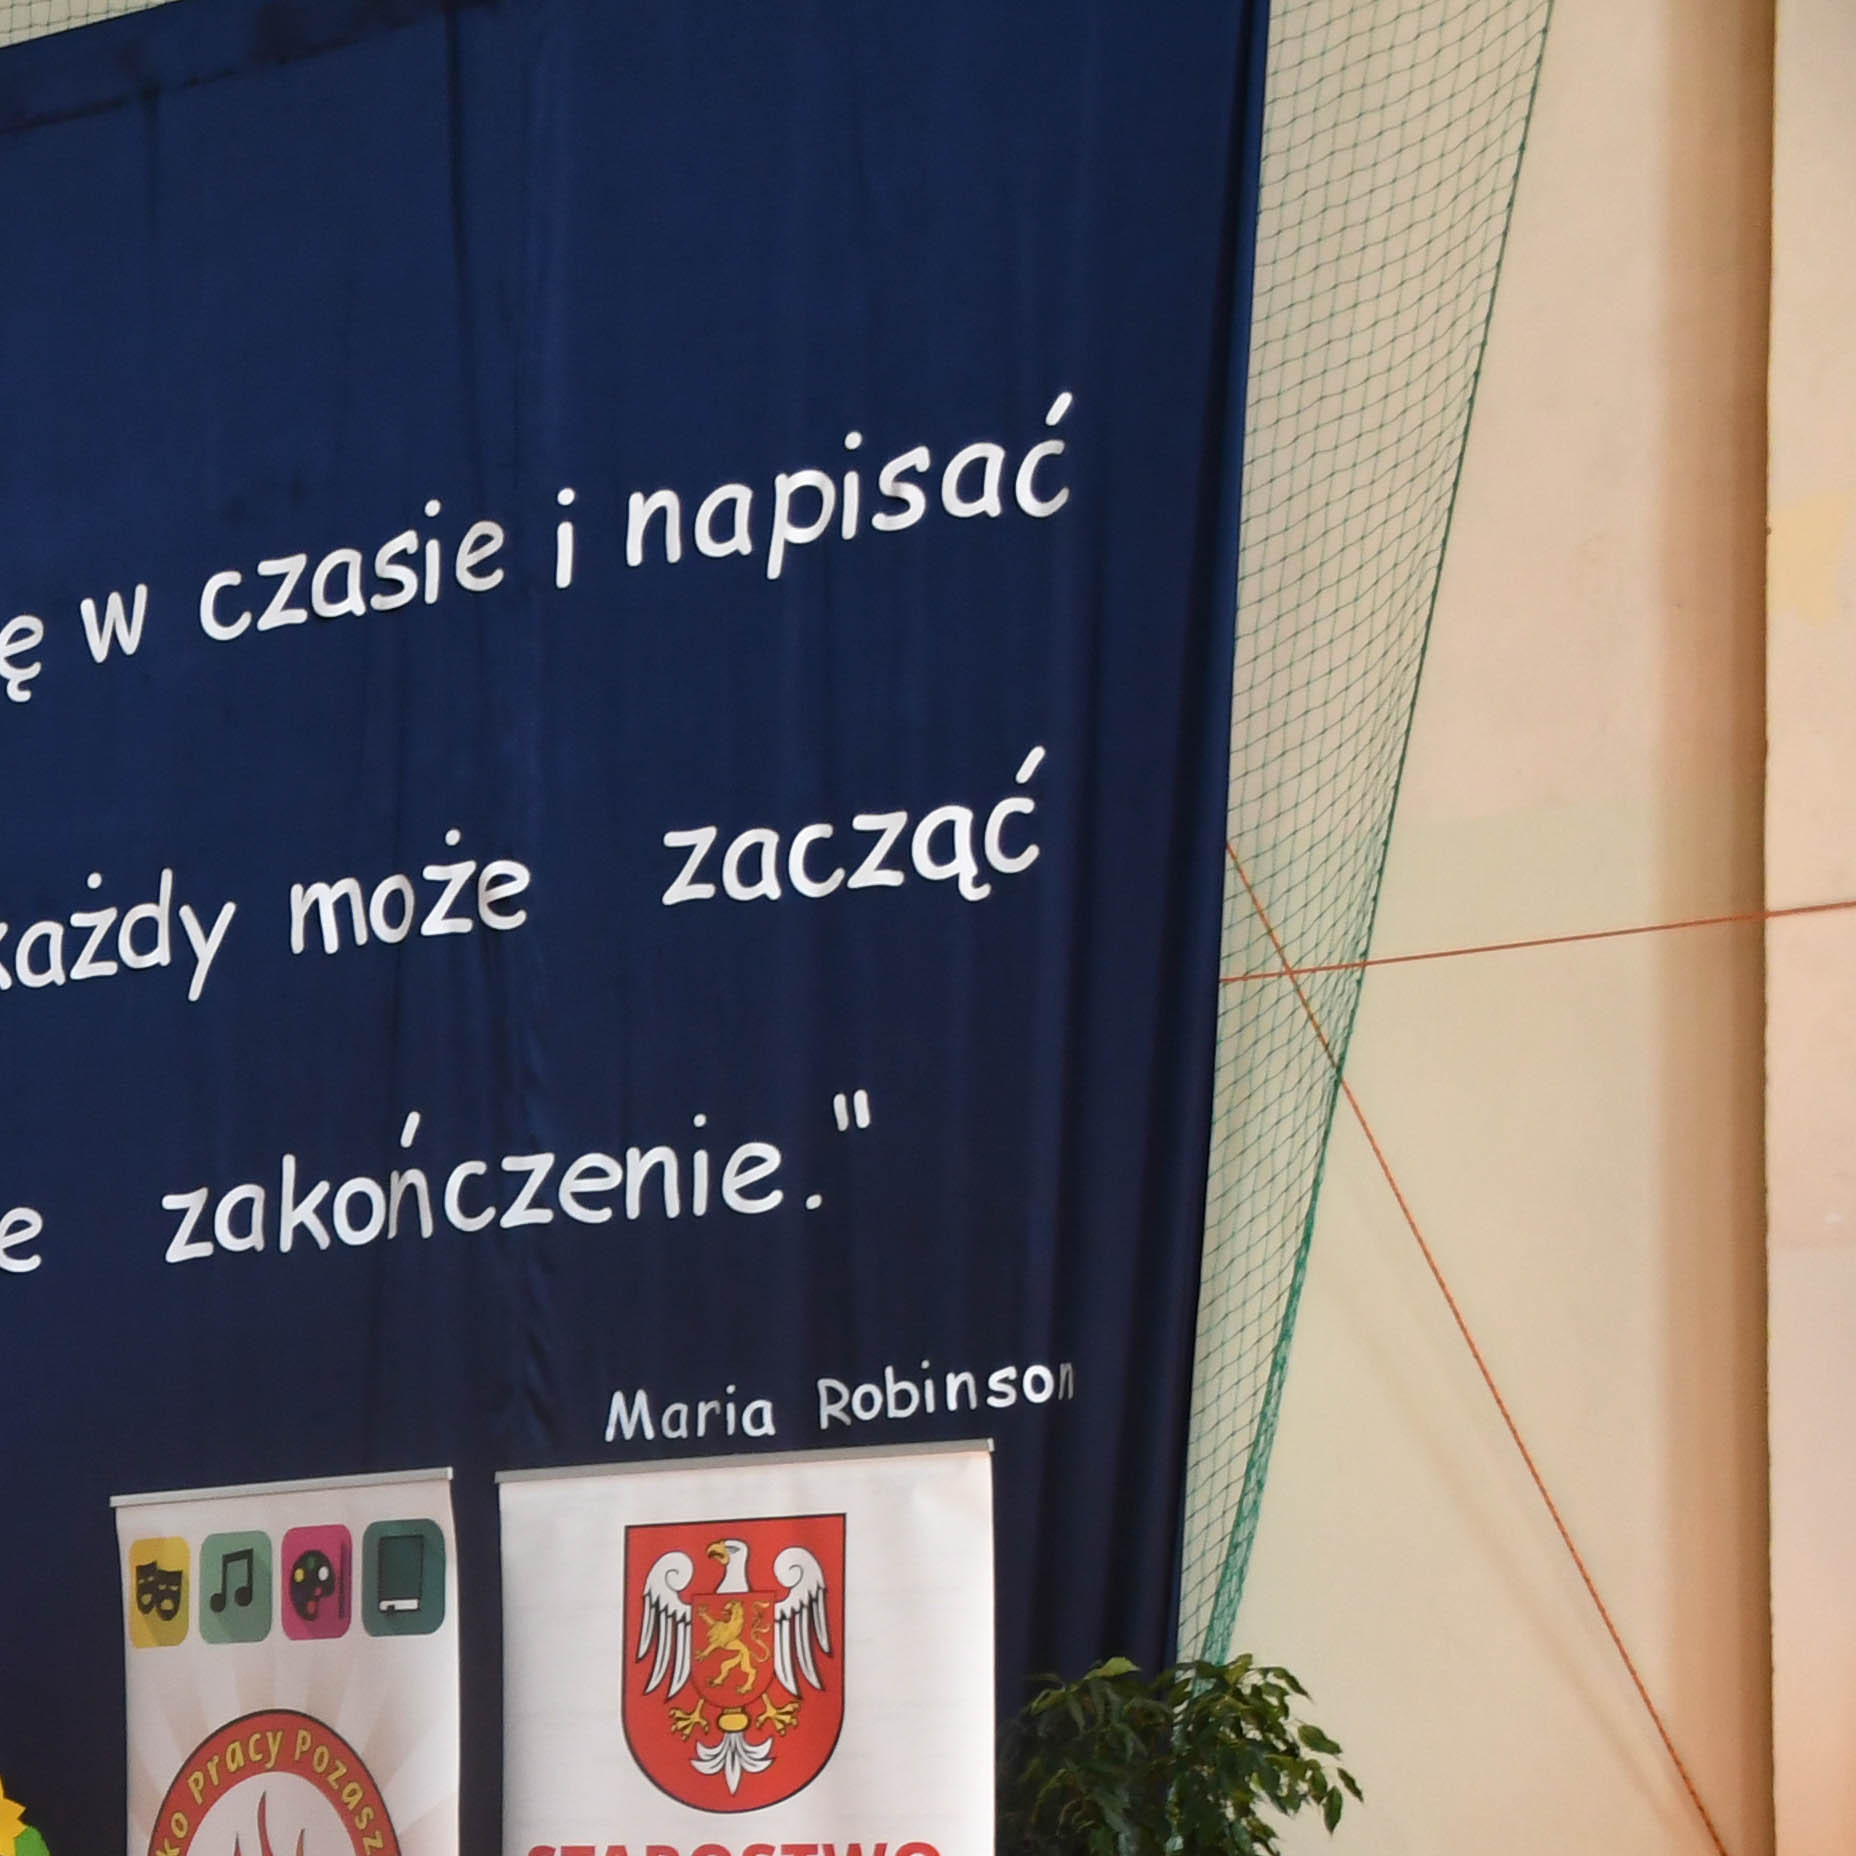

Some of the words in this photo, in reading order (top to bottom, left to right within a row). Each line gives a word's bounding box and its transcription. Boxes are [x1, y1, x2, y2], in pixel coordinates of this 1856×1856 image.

[80, 583, 148, 664] w
[199, 499, 505, 641] czasie
[554, 487, 576, 589] i
[626, 391, 1073, 580] napisać
[290, 828, 531, 955] może
[661, 745, 1046, 906] zacząć
[604, 1384, 776, 1442] Maria
[817, 1360, 1074, 1430] Robinson
[187, 1728, 284, 1805] Pracy
